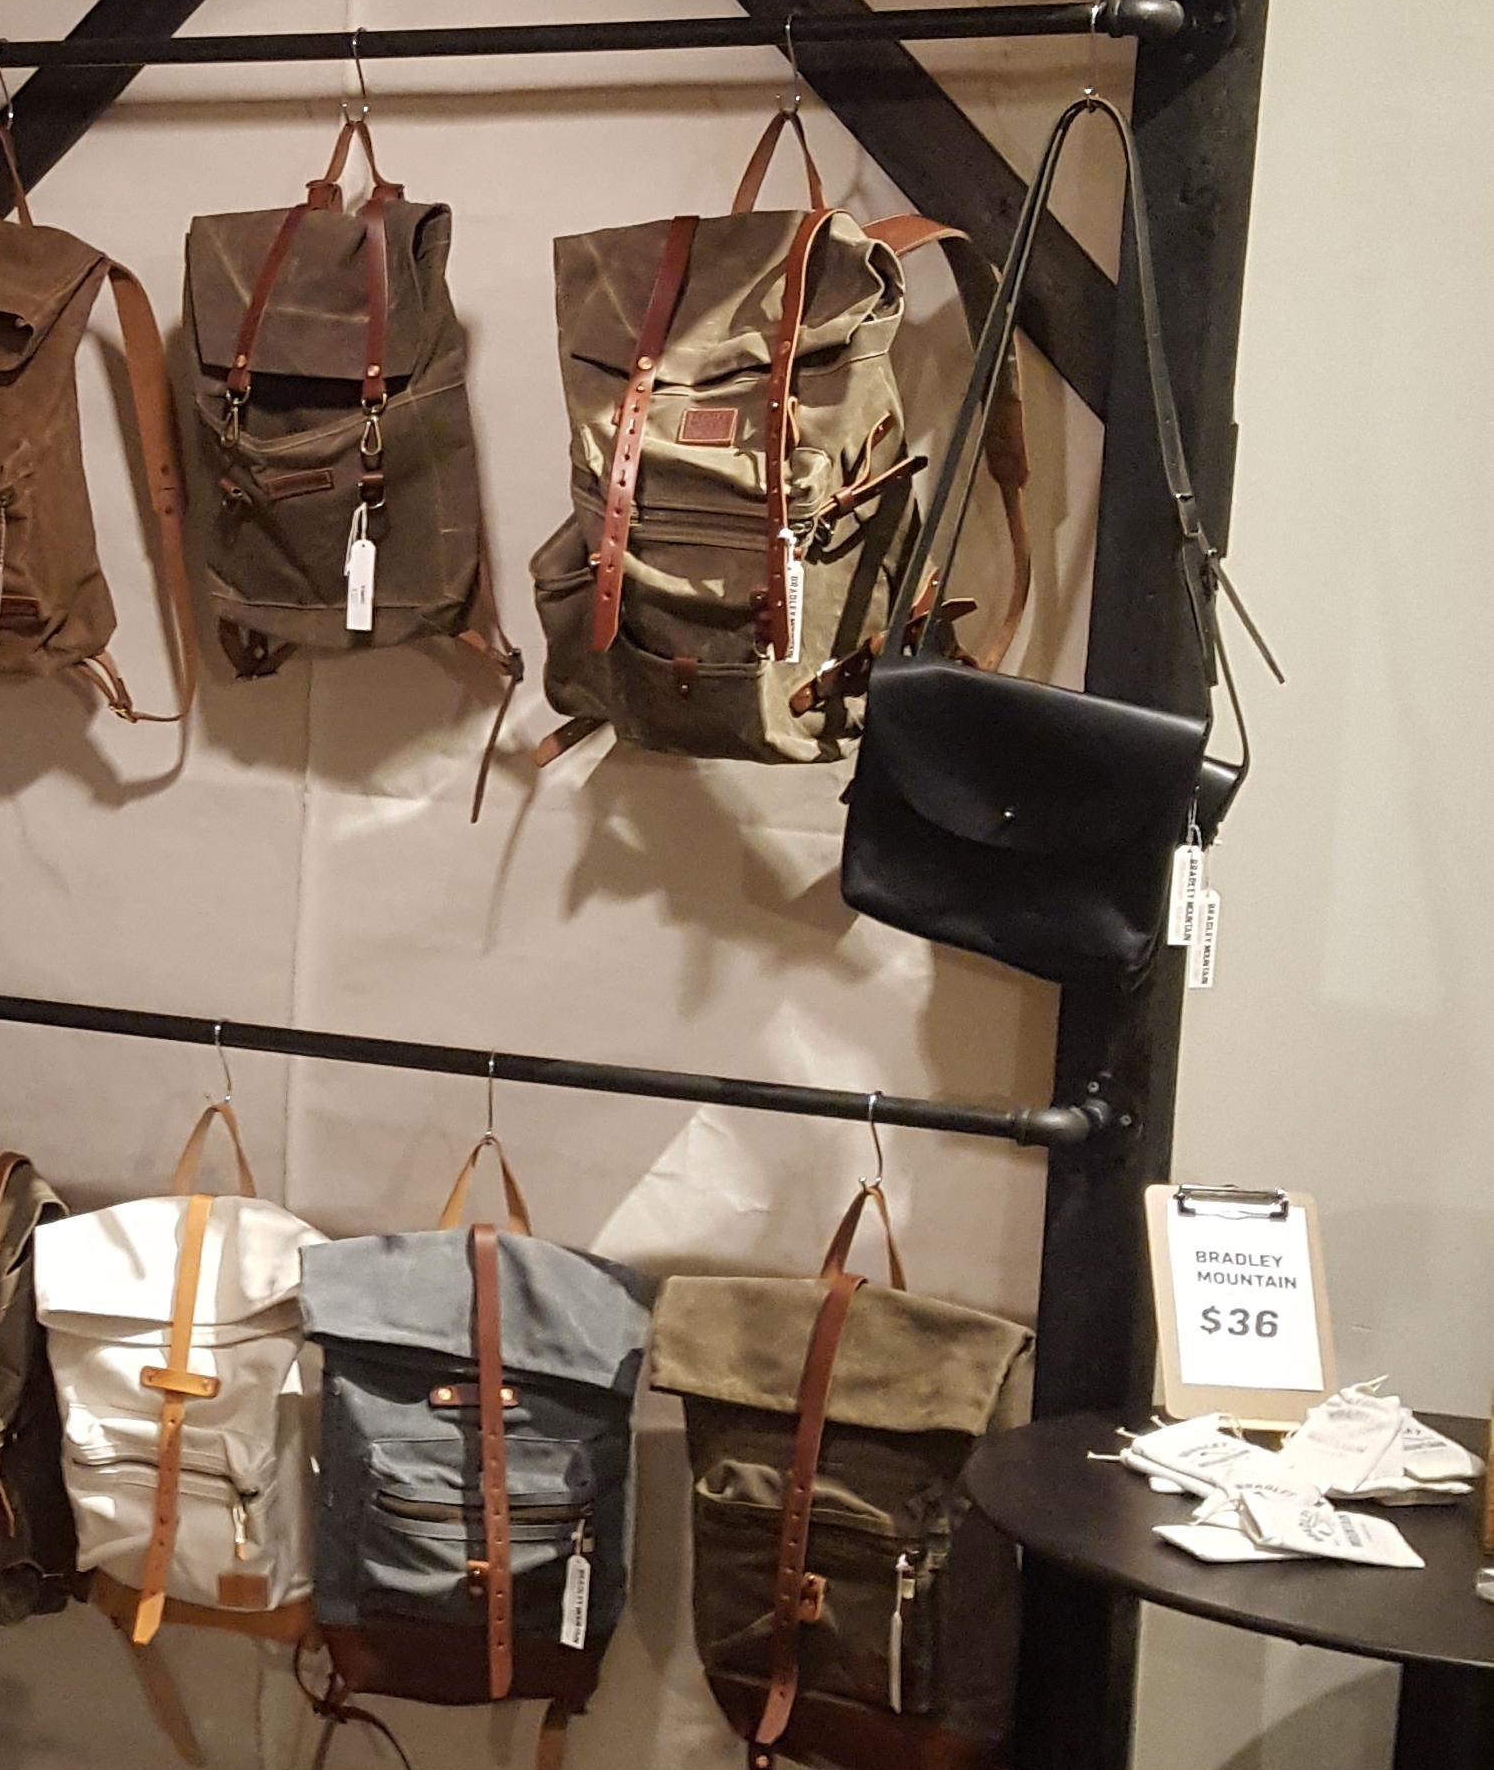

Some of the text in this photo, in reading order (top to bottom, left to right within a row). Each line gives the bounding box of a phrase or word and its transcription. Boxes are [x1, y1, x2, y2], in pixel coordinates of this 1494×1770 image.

[1195, 1250, 1283, 1268] BRADLEY
[1196, 1270, 1298, 1289] MOUNTAIN
[1200, 1305, 1279, 1338] $36
